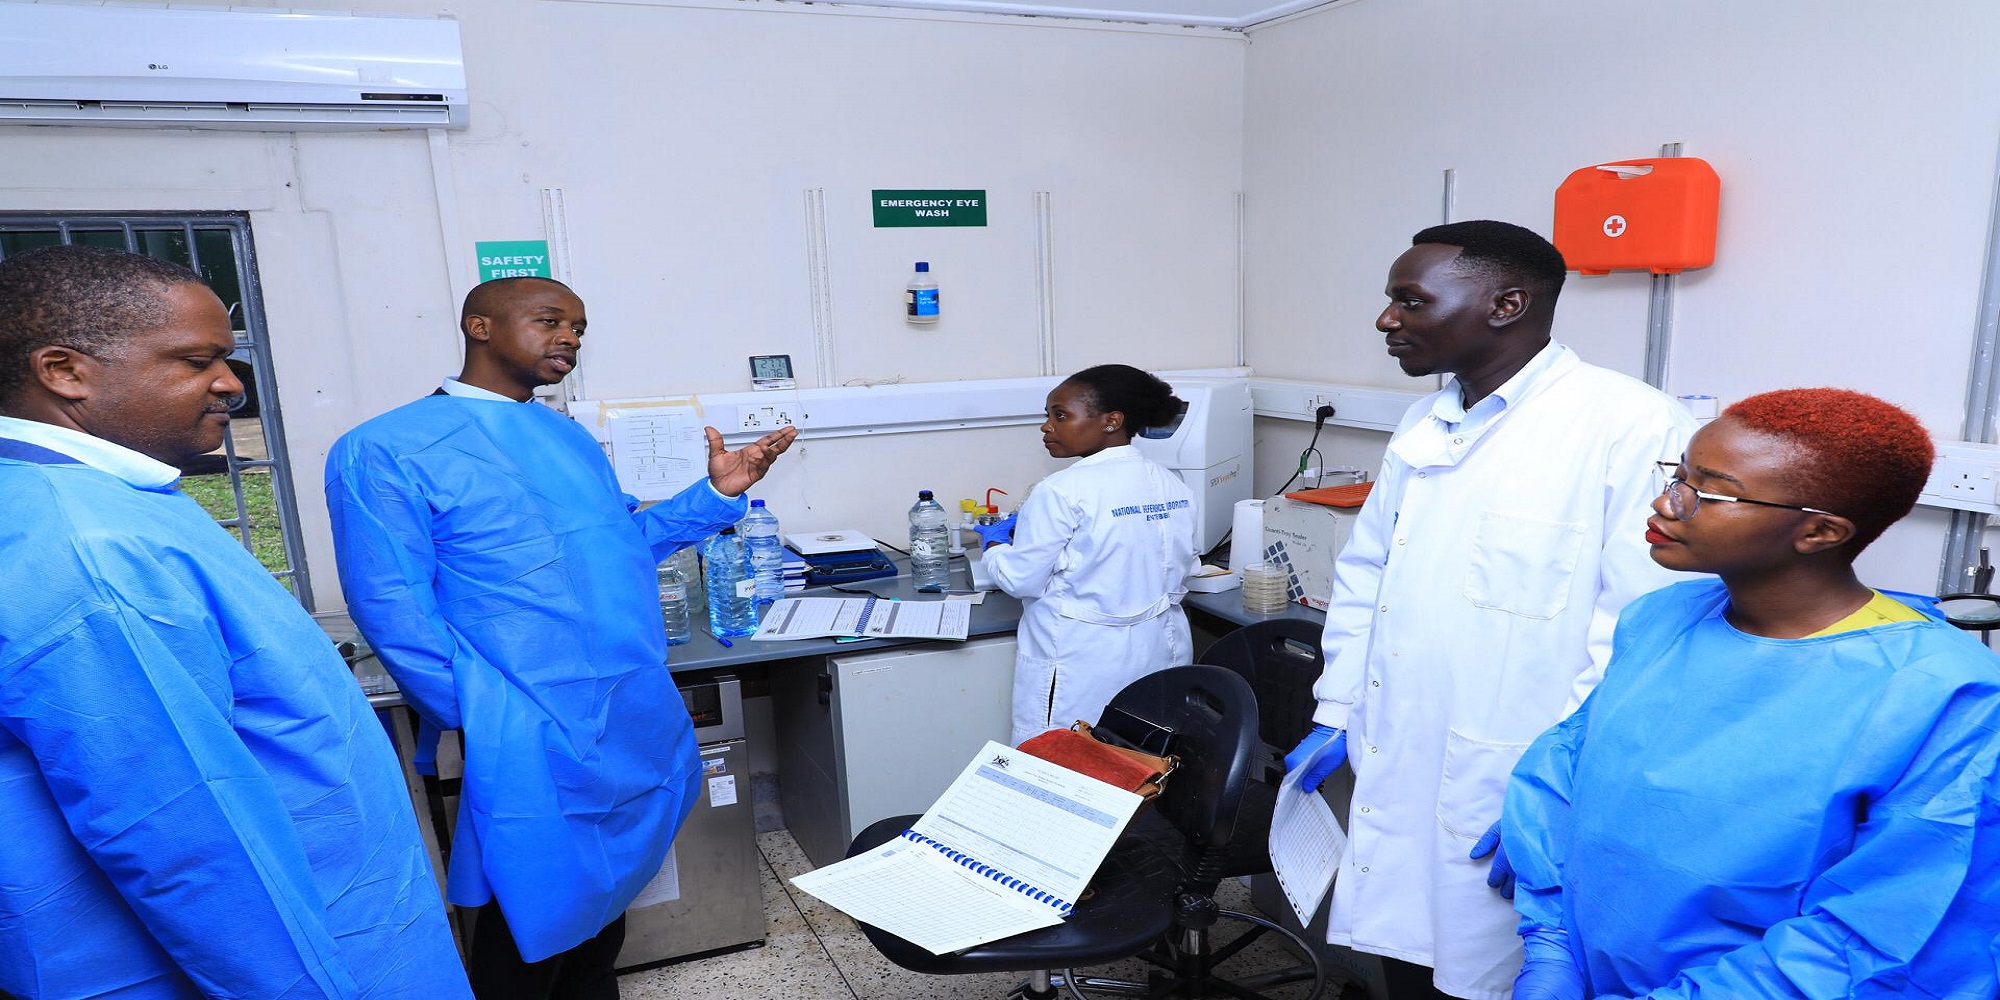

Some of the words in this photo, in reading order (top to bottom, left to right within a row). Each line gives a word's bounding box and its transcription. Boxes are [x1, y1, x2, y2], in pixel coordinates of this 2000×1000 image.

[880, 199, 953, 207] EMERGENCY
[956, 199, 979, 207] EYE
[915, 209, 950, 217] WASH
[481, 255, 544, 266] SAFETY
[491, 268, 538, 278] FIRST
[1111, 505, 1142, 517] NATIONAL
